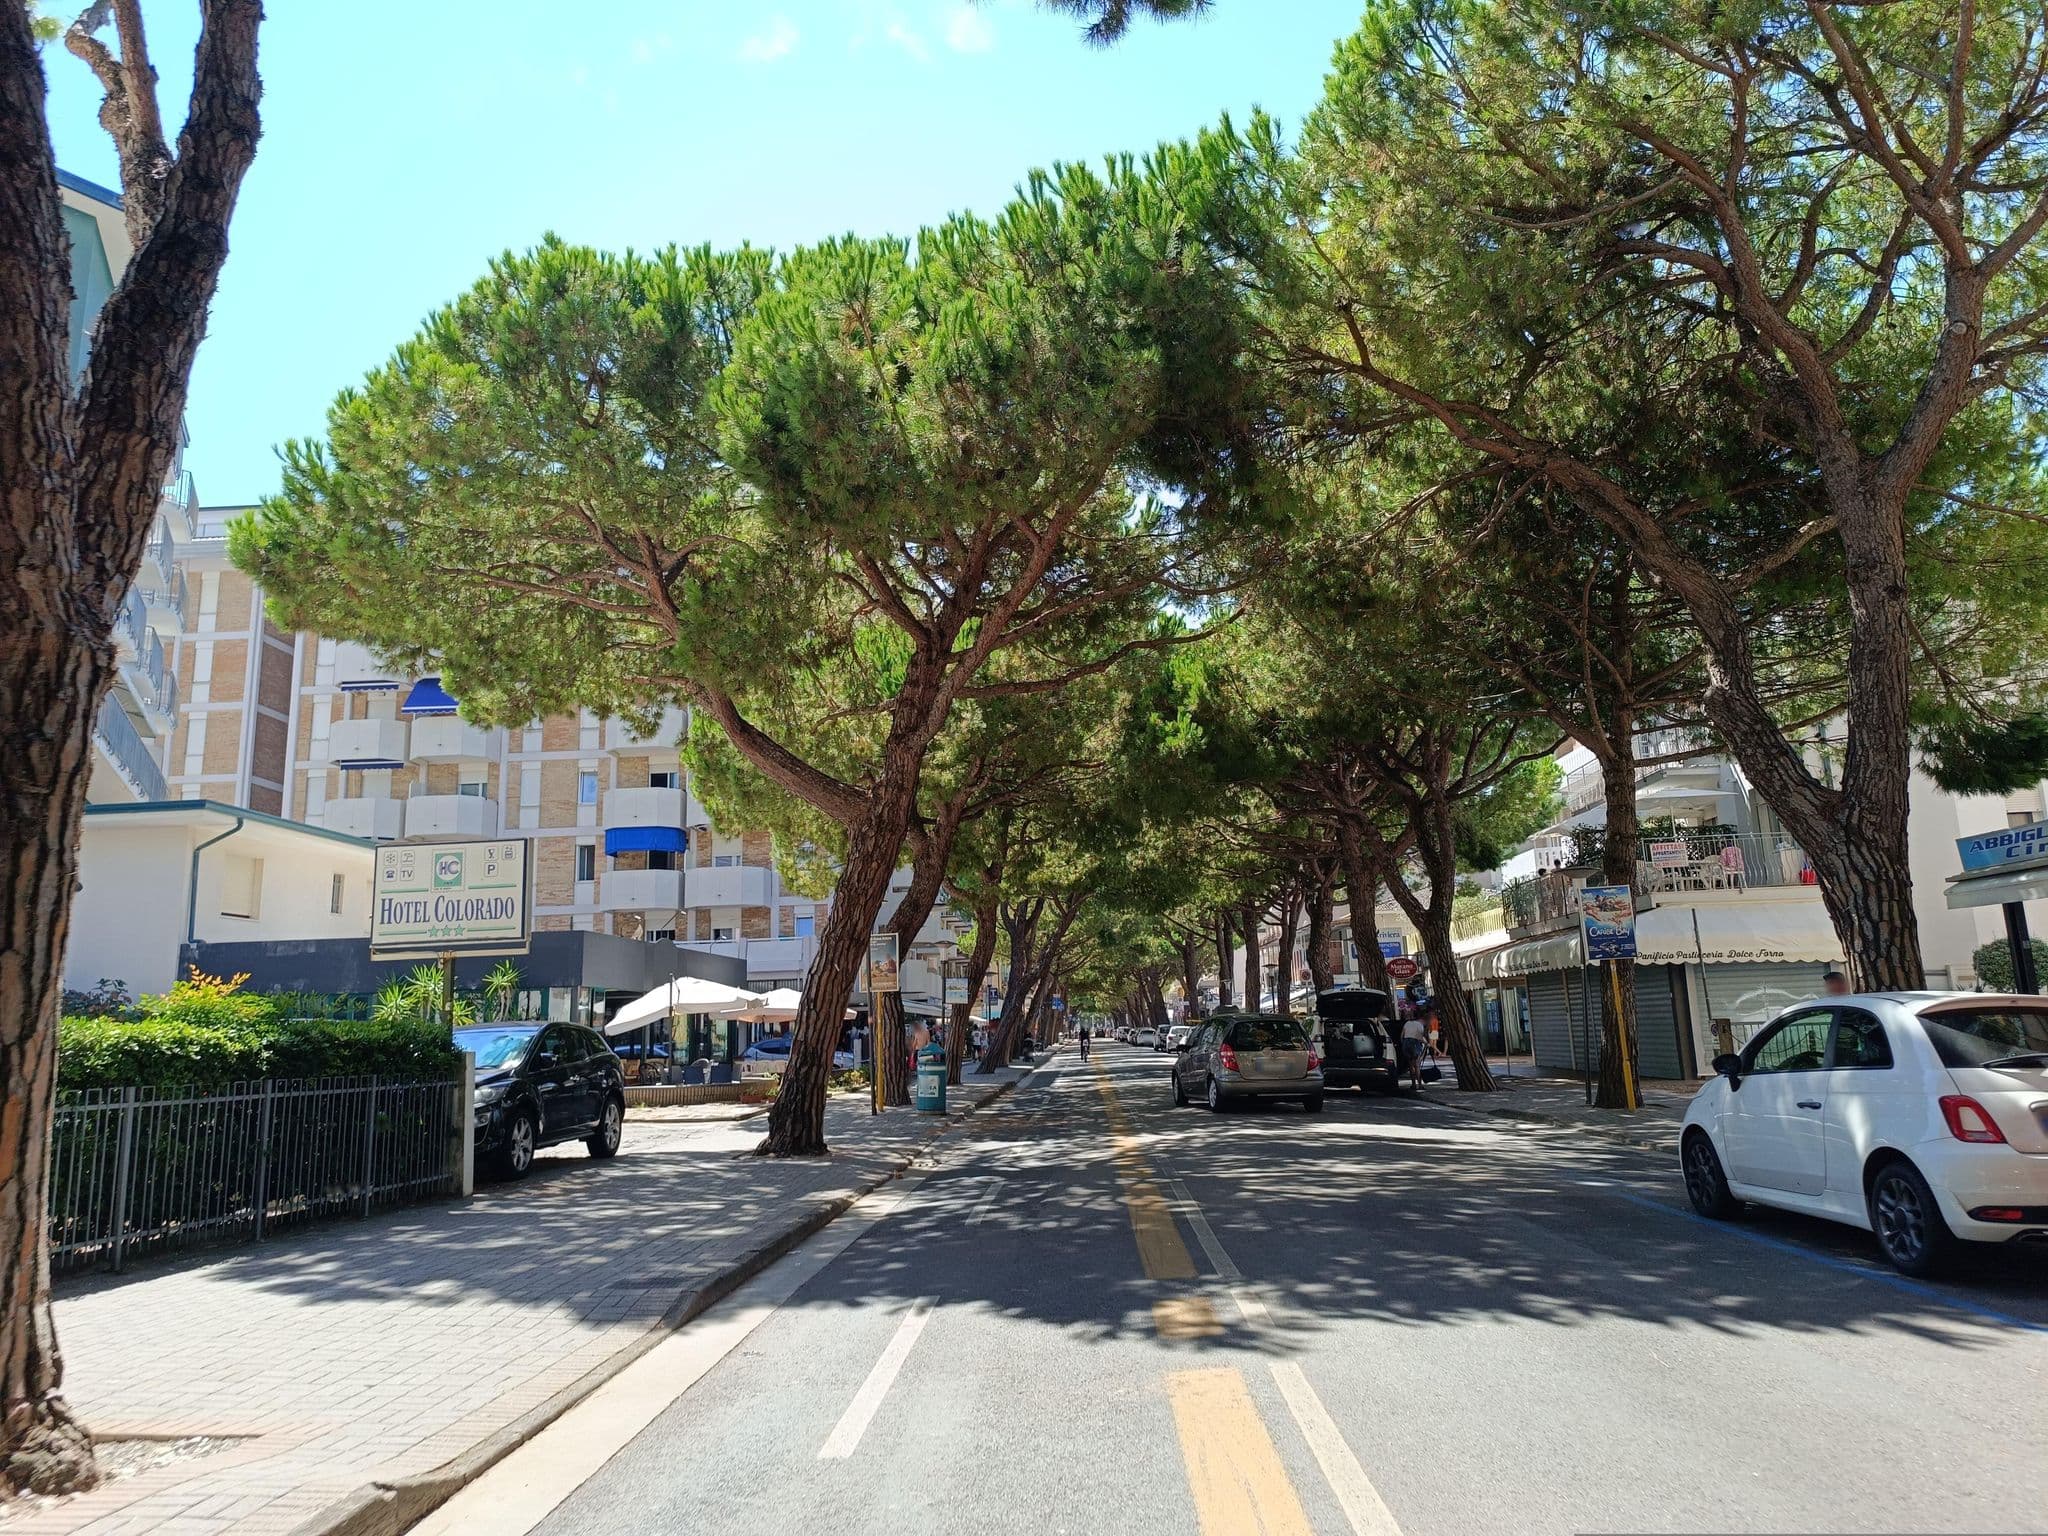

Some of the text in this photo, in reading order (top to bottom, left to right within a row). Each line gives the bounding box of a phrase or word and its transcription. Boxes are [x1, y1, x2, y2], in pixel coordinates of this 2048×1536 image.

[400, 869, 414, 878] TV
[487, 864, 496, 875] P
[379, 895, 515, 925] HOTEL COLORADO
[1727, 949, 1754, 958] Dolce
[1756, 948, 1784, 958] Forno
